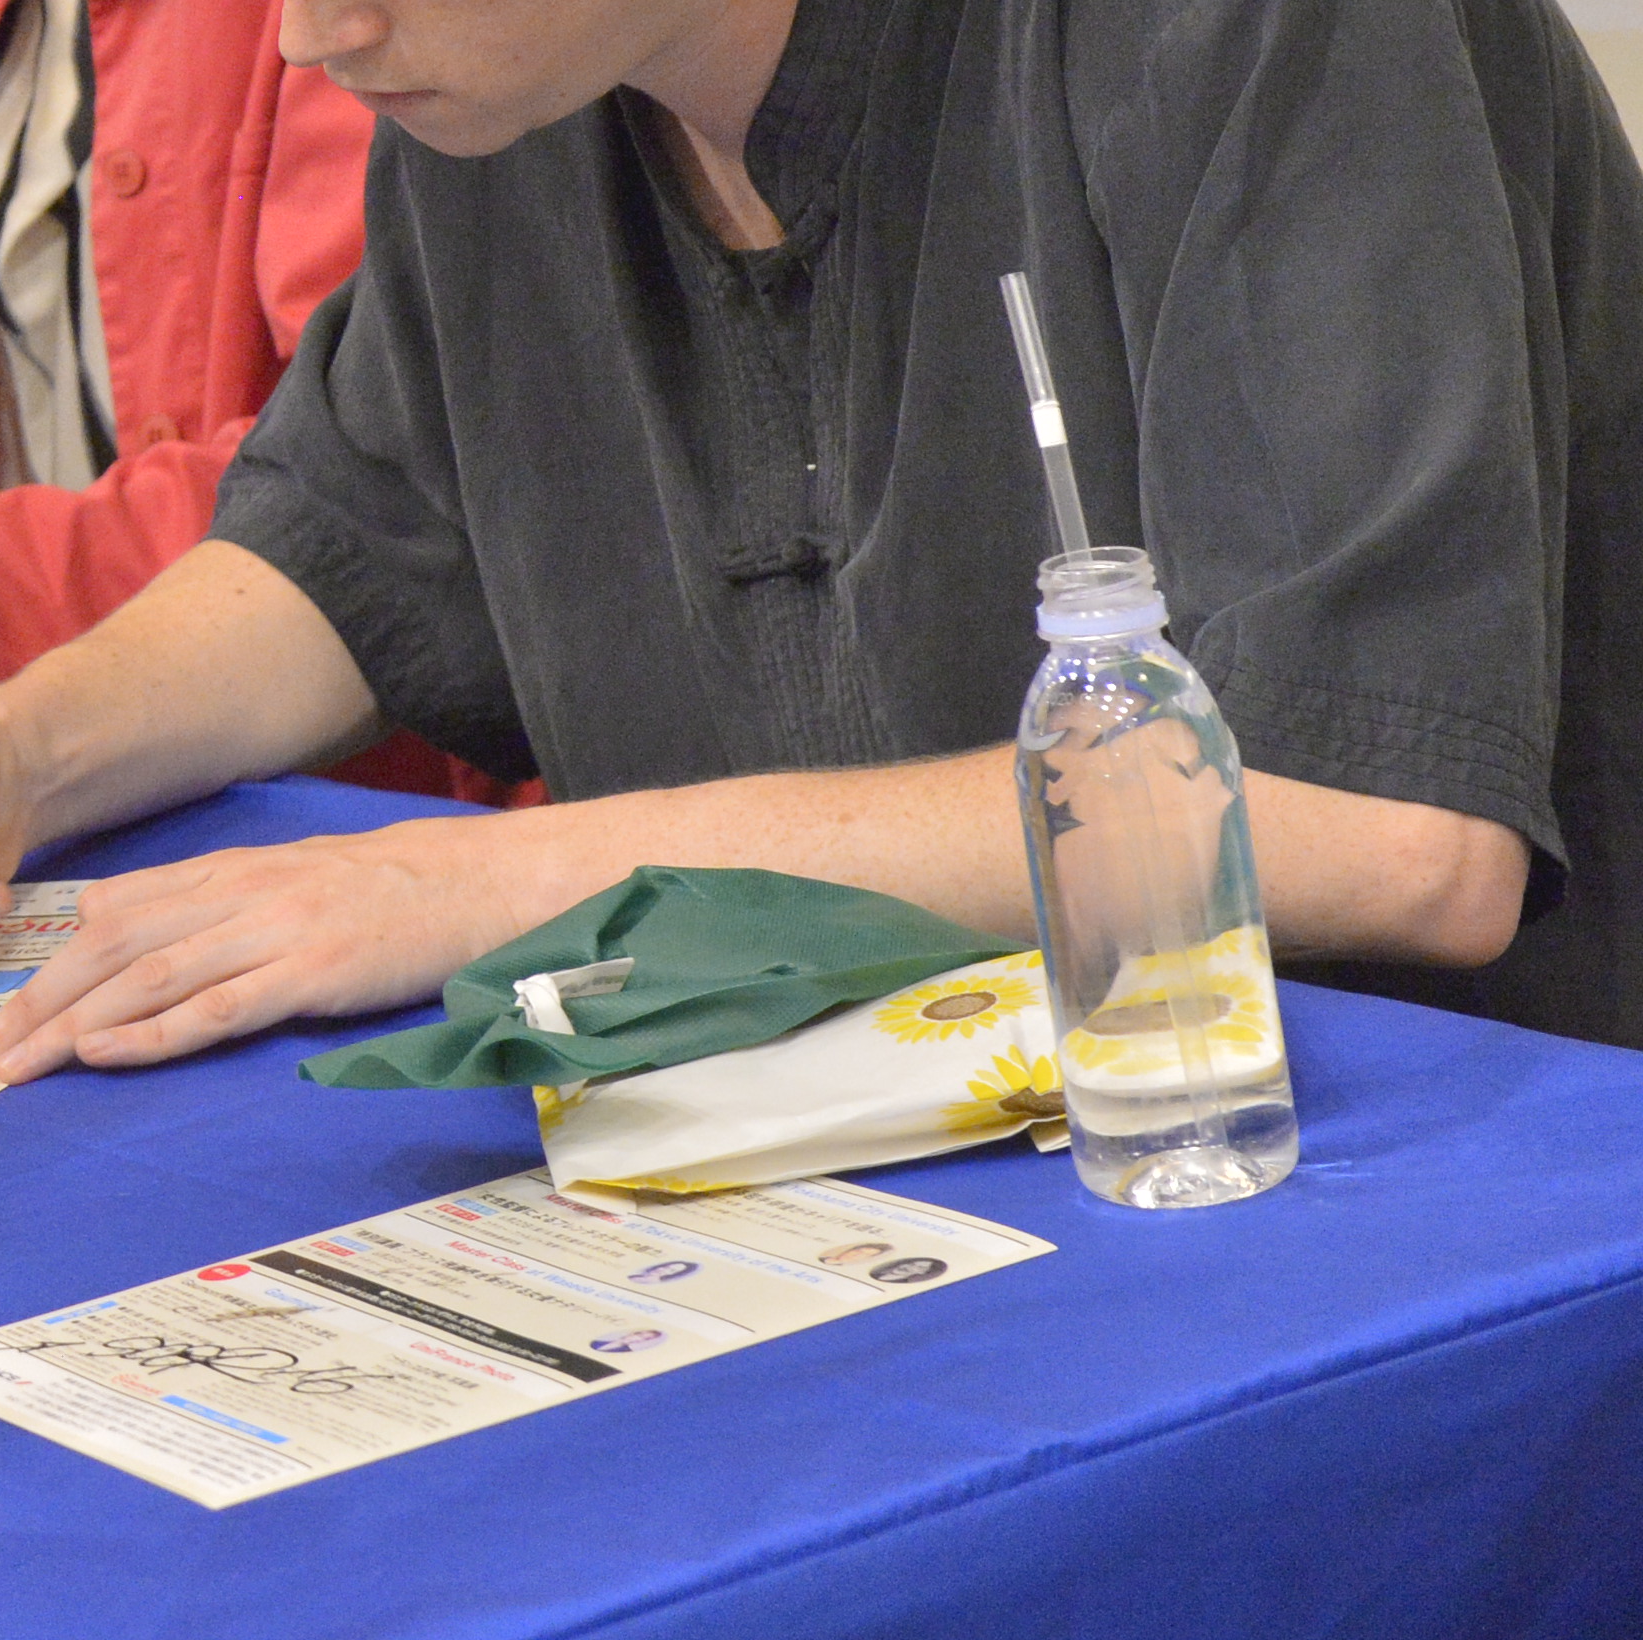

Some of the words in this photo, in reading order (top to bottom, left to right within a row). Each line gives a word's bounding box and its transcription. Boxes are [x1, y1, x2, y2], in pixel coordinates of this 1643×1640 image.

[786, 1185, 859, 1207] Yokohama
[853, 1205, 888, 1216] City
[884, 1213, 962, 1235] University
[680, 1238, 748, 1261] University
[447, 1241, 492, 1258] Master
[491, 1256, 528, 1270] Class
[543, 1273, 596, 1293] Waseda
[595, 1291, 662, 1314] University
[408, 1341, 478, 1367] UniFrance
[473, 1365, 517, 1381] Photo
